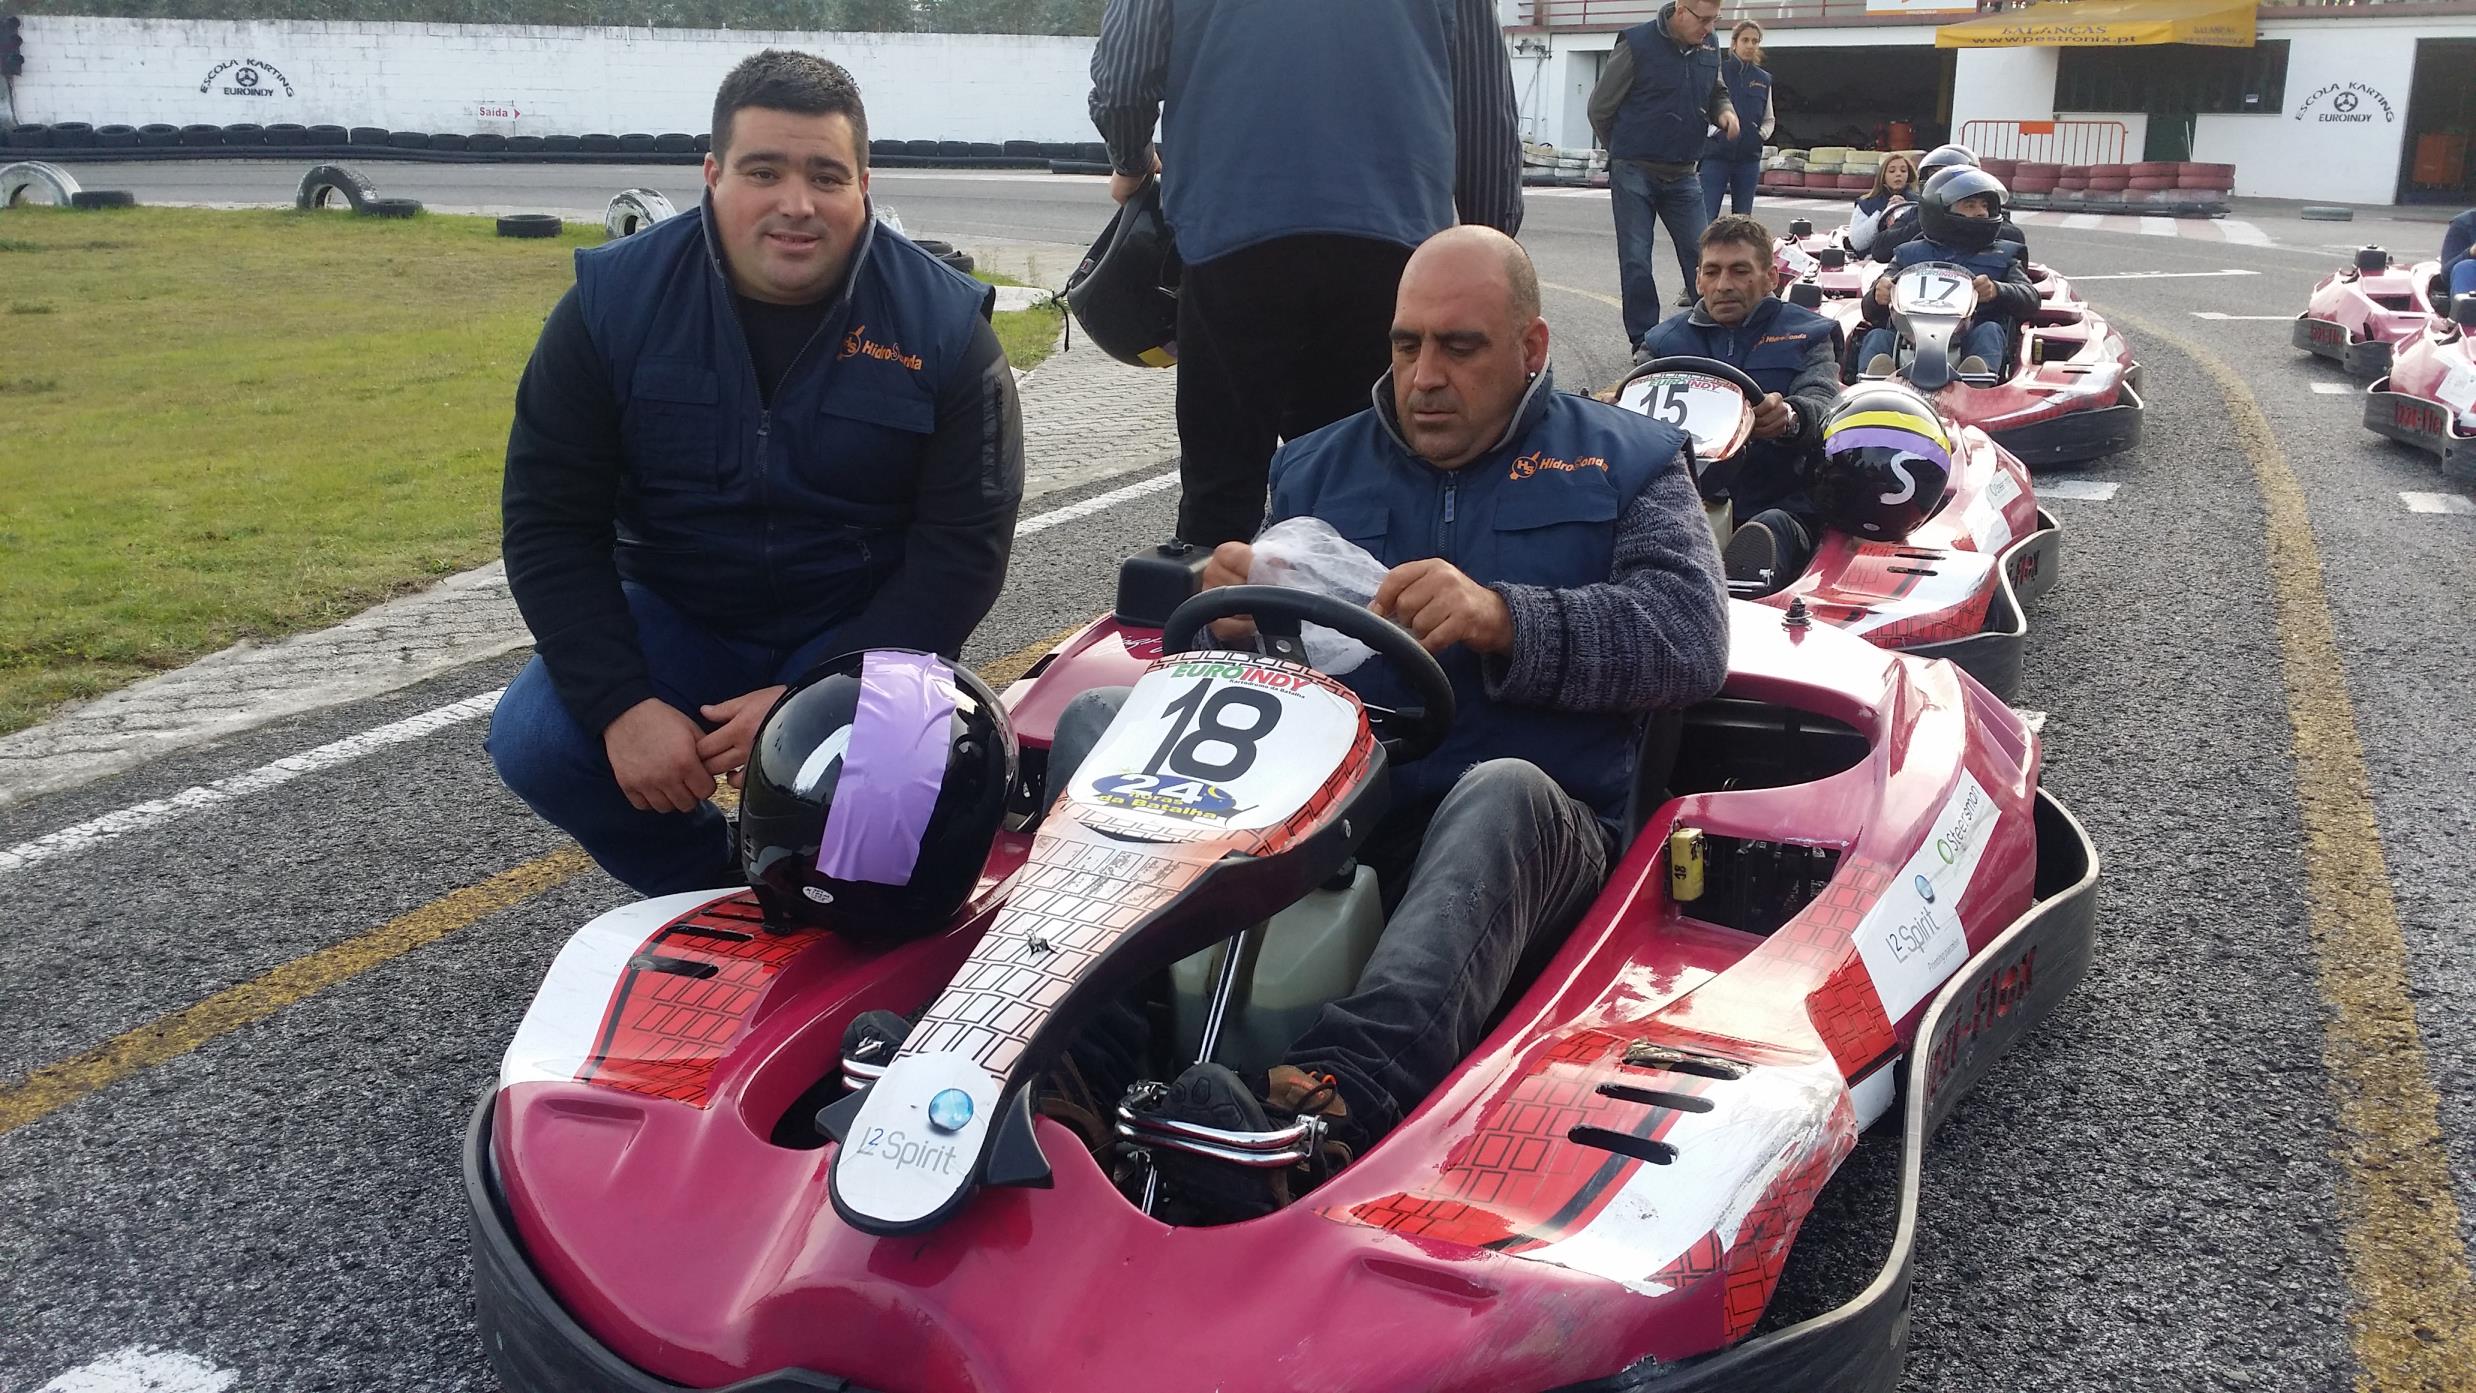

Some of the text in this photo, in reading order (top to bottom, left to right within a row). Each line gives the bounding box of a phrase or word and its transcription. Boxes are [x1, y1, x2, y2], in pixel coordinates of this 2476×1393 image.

[200, 58, 295, 97] ESCOLA KARTING
[223, 87, 274, 97] EUROINDY
[2295, 81, 2395, 123] ESCOLA KARTING
[2319, 112, 2373, 122] EUROINDY
[1919, 276, 1961, 303] 17
[1640, 383, 1688, 428] 15
[1171, 663, 1312, 692] EUROINDY
[1141, 677, 1283, 783] 18
[1110, 774, 1204, 804] 24
[1098, 794, 1218, 820] da Batalha
